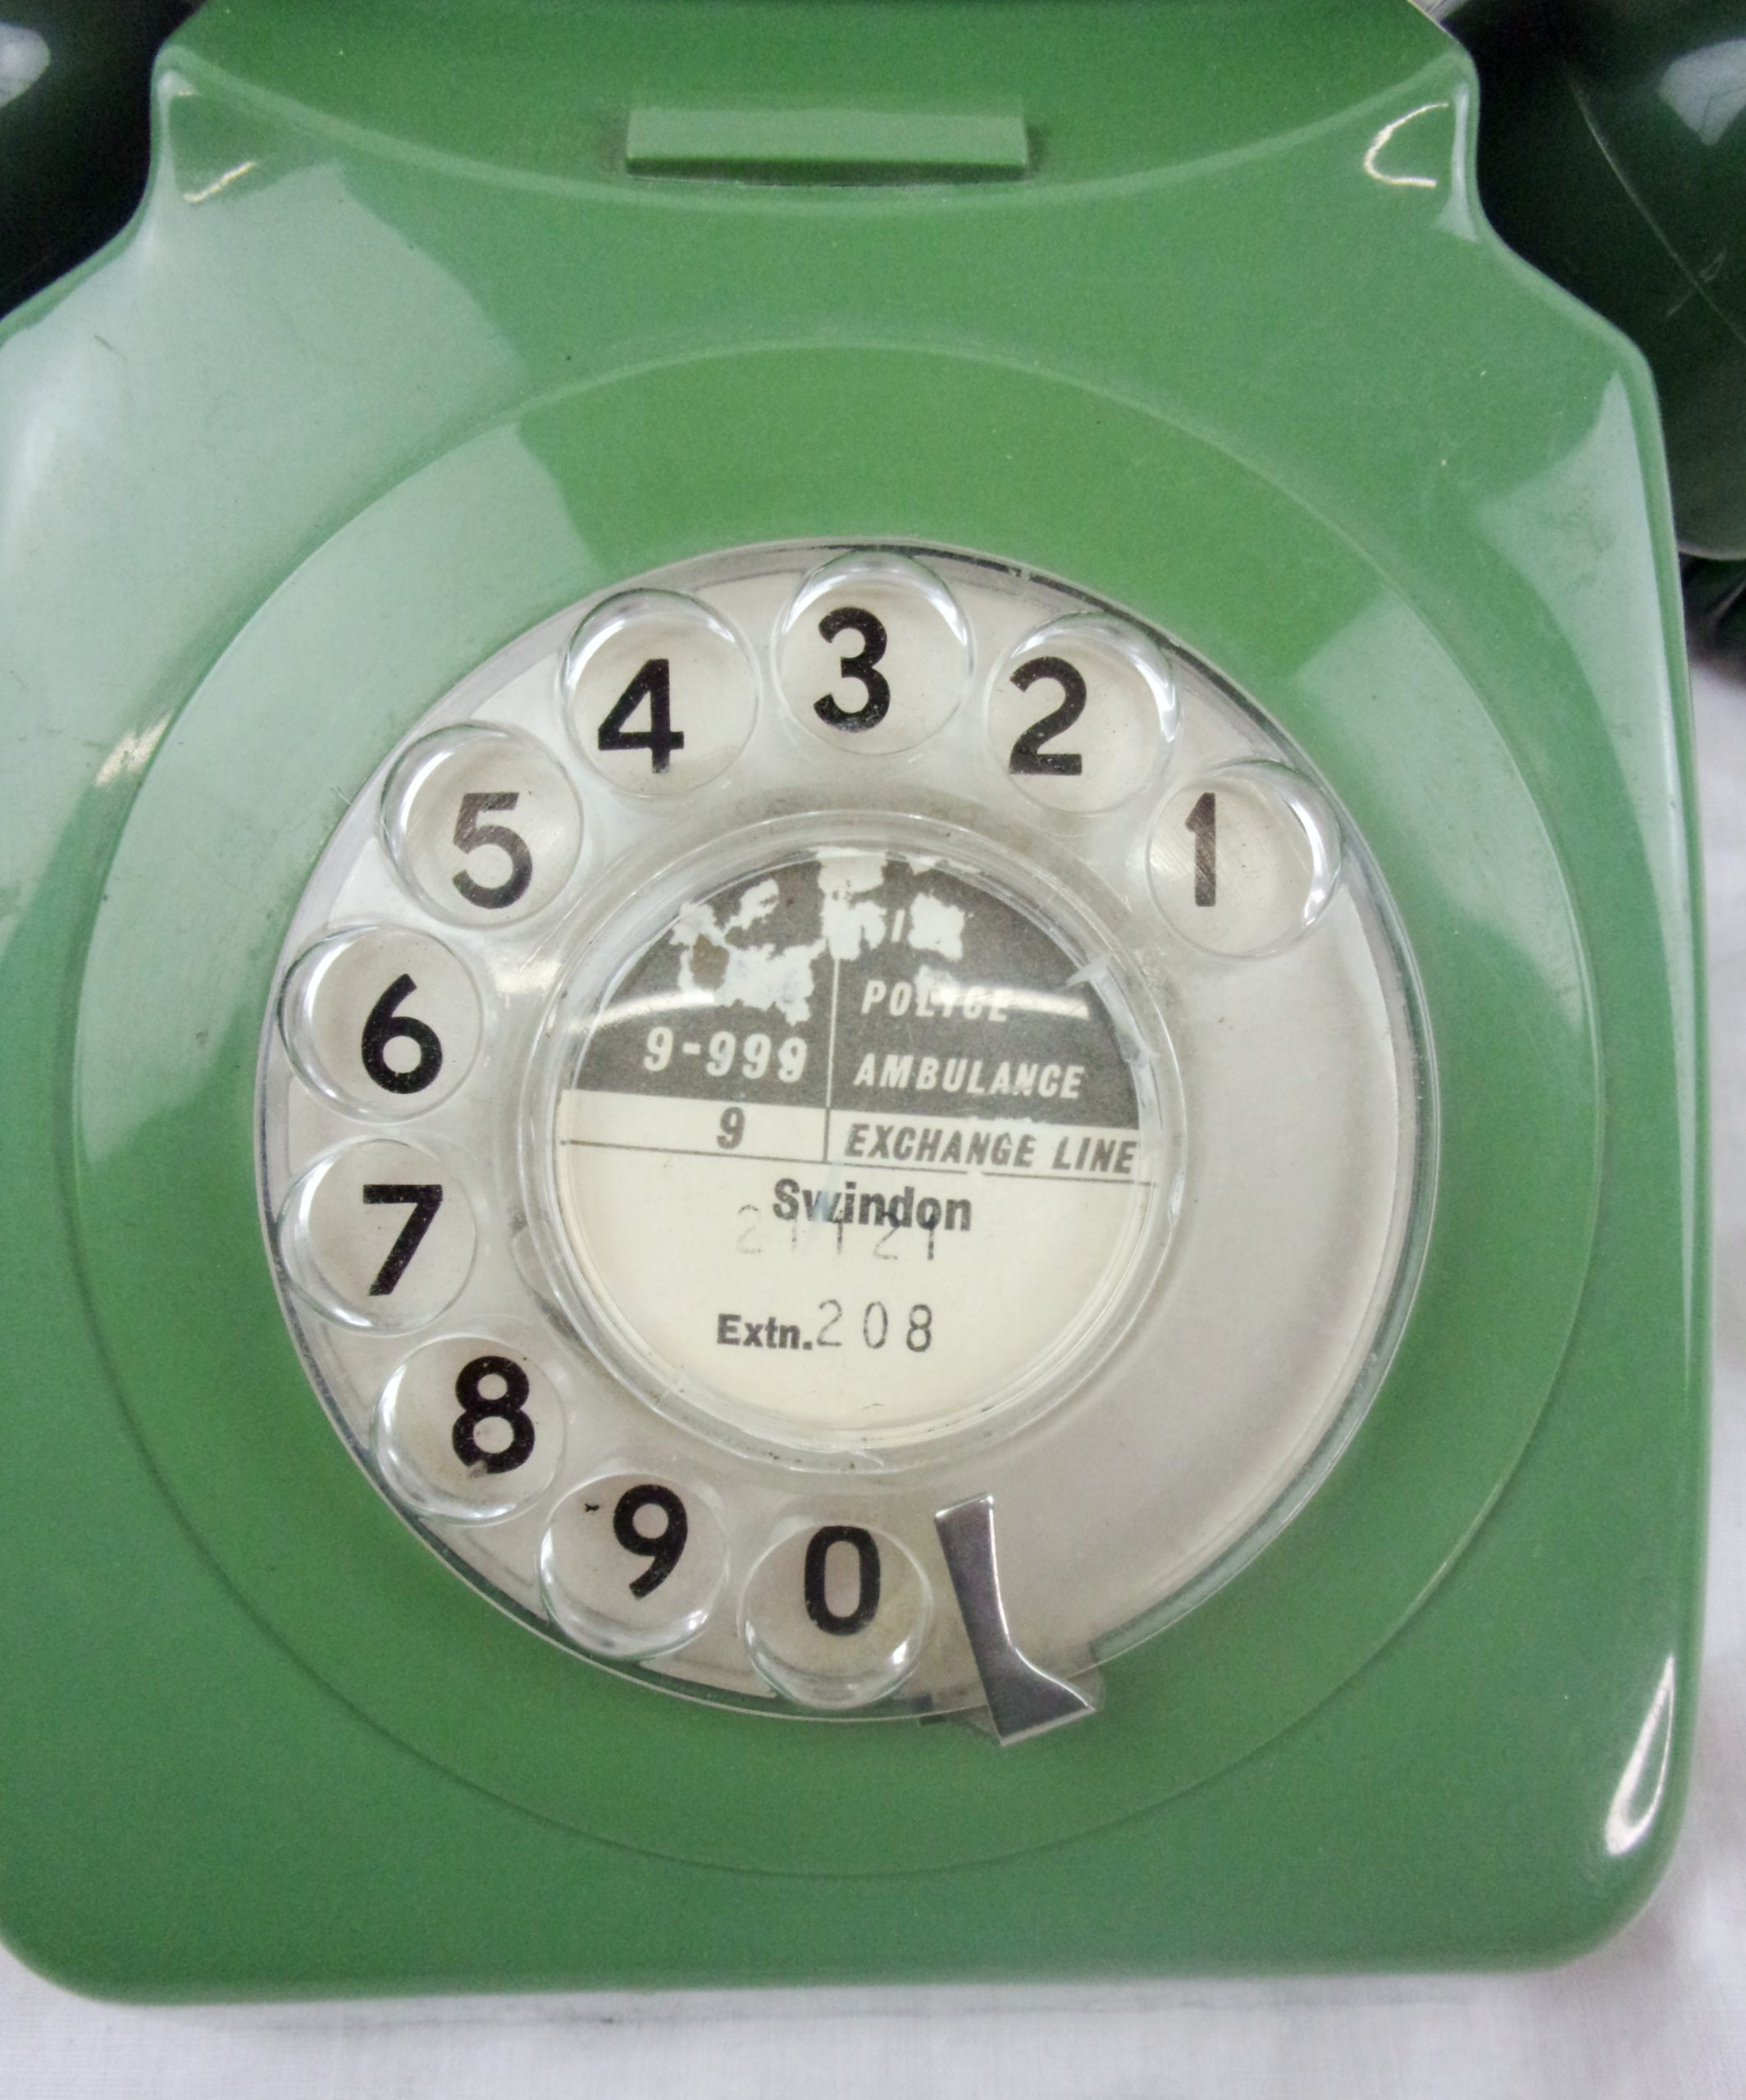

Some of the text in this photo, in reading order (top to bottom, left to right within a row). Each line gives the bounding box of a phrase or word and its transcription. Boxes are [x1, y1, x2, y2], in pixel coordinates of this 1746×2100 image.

[597, 658, 685, 774] 4
[812, 606, 891, 733] 3
[1008, 656, 1087, 776] 2
[451, 791, 534, 910] 5
[1184, 792, 1217, 908] 1
[360, 973, 444, 1095] 6
[642, 1026, 809, 1084] 9-999
[861, 979, 1014, 1023] POLICE
[715, 1106, 746, 1150] 9
[853, 1052, 1085, 1099] AMBULANCE
[773, 1178, 972, 1231] Swindon
[843, 1122, 1138, 1175] EXCHANGE LINE
[362, 1184, 444, 1297] 7
[717, 1299, 935, 1353] Extn. 208
[450, 1355, 536, 1476] 8
[611, 1482, 690, 1601] 9
